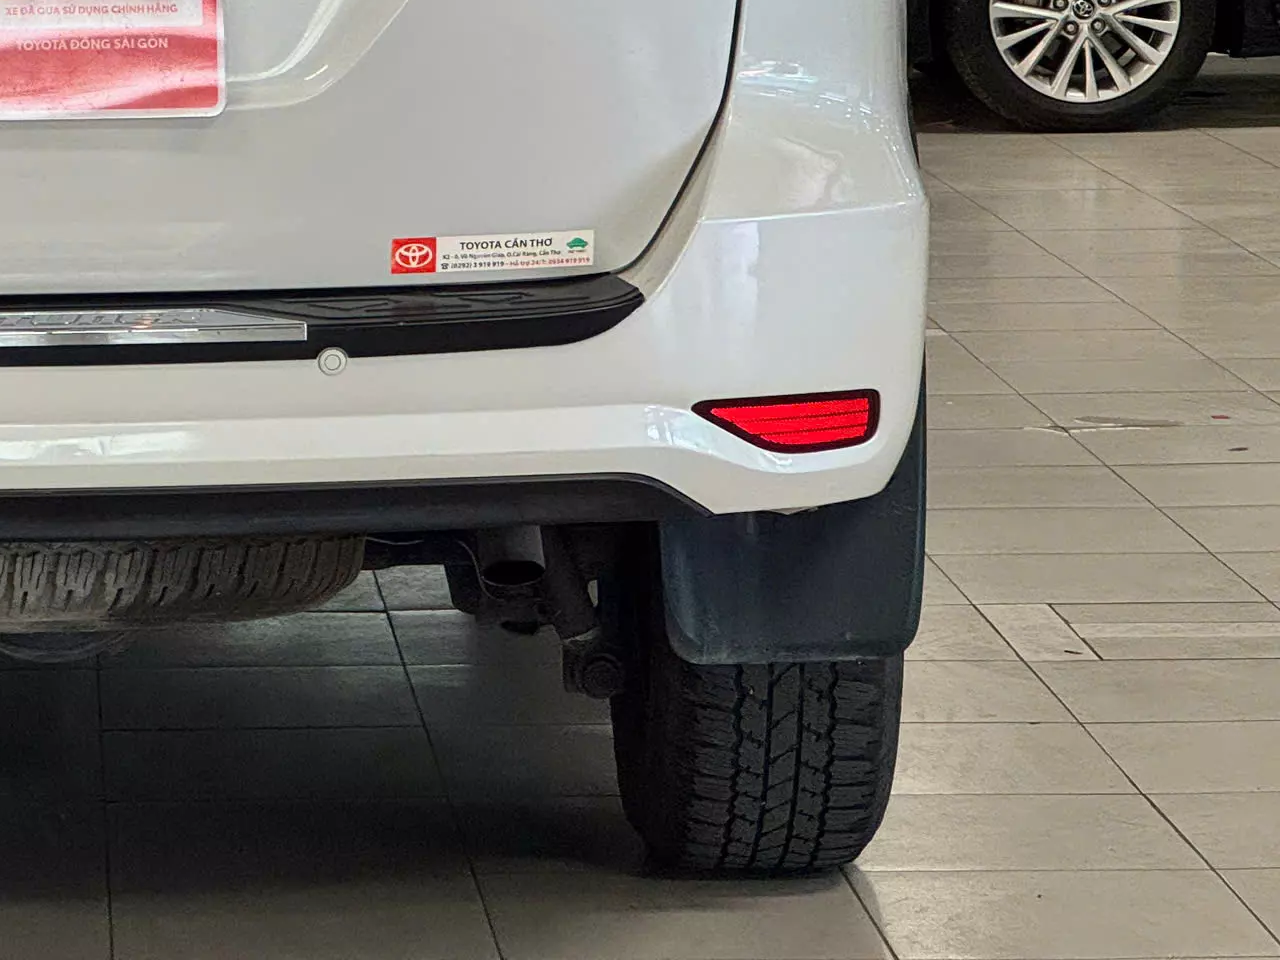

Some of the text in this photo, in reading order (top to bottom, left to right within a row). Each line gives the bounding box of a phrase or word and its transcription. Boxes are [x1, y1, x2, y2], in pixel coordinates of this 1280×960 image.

[5, 7, 19, 16] XE
[78, 5, 110, 16] DỤNG
[18, 39, 68, 51] TOYOTA
[70, 37, 111, 50] ĐÔNG
[460, 240, 502, 250] TOYOTA
